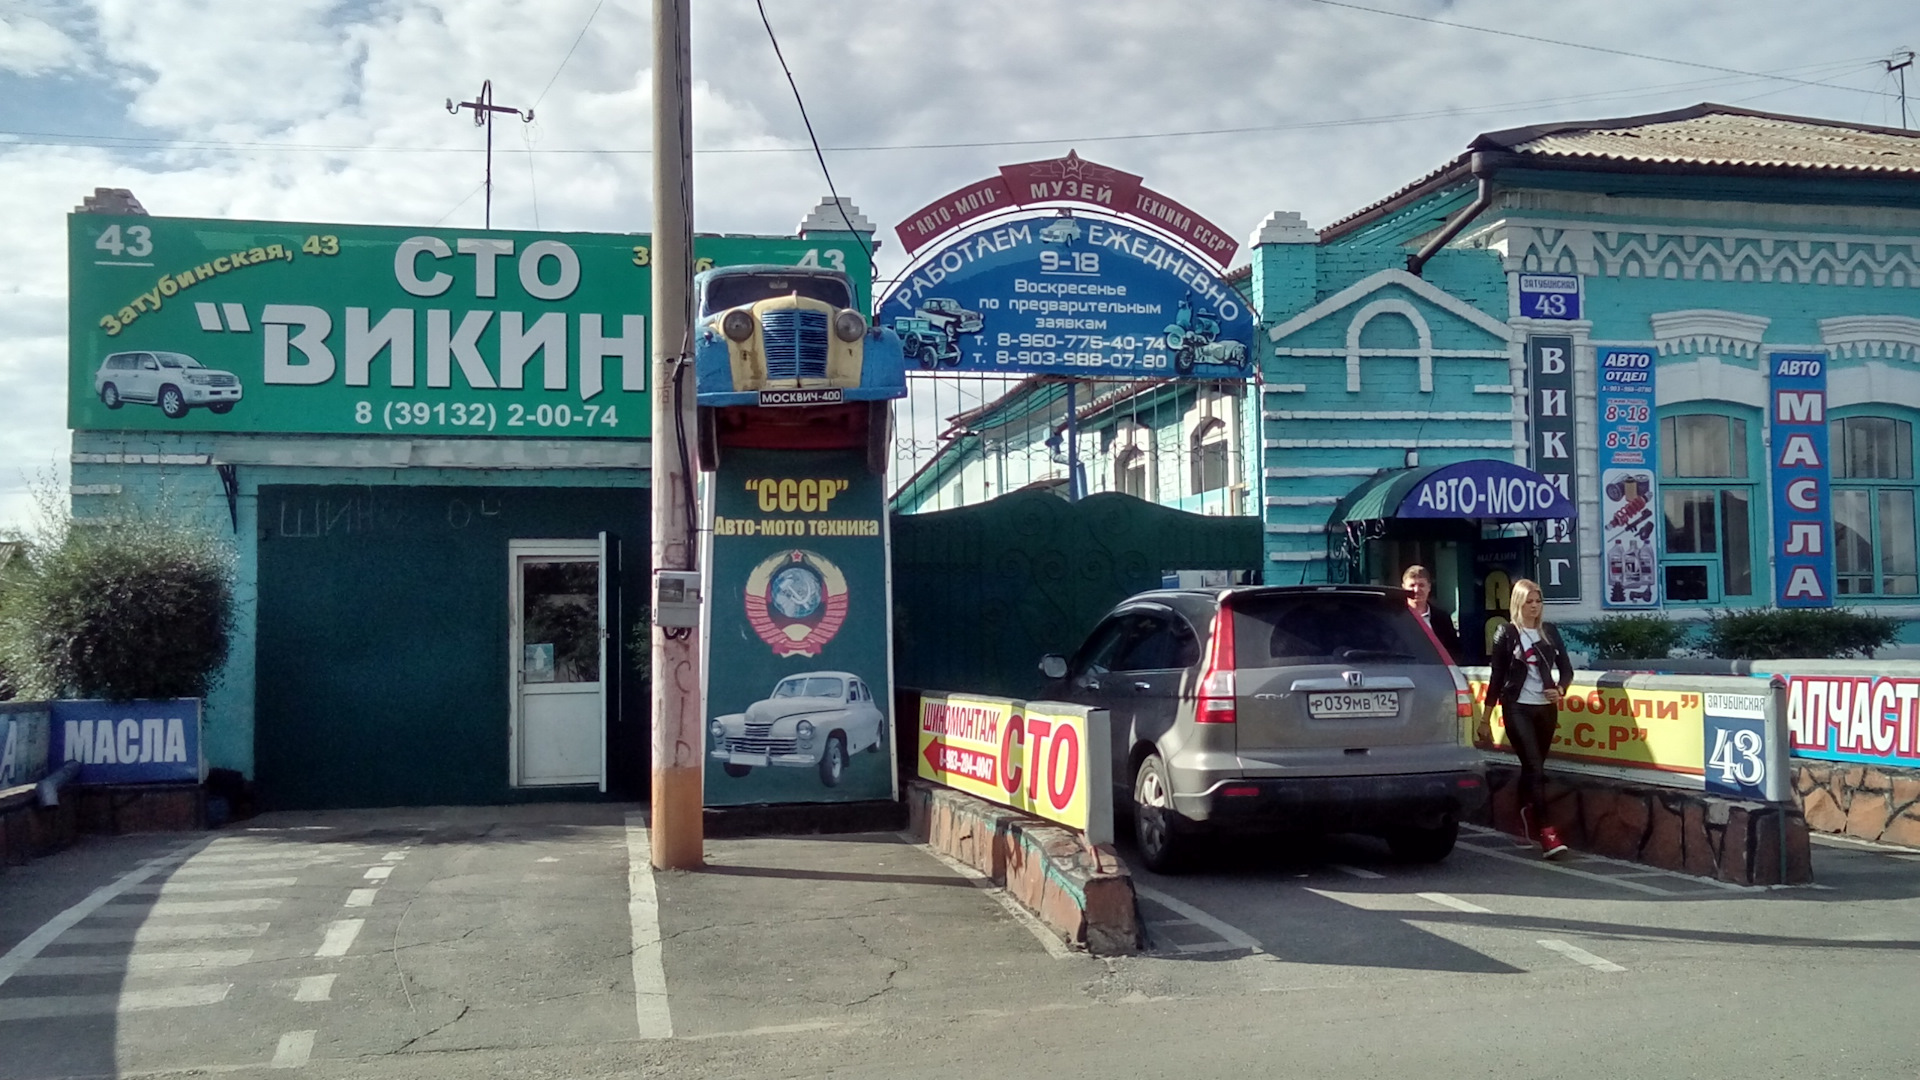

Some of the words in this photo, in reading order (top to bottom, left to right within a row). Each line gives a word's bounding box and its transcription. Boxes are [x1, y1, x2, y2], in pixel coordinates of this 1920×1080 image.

[1030, 180, 1113, 204] МУЗЕЙ
[1136, 193, 1192, 232] ТЕХНИКА
[1193, 224, 1234, 252] СССР"
[96, 224, 153, 257] 43
[395, 236, 582, 300] СТО
[896, 224, 1032, 311] РАБОТАЕМ
[1088, 224, 1239, 321] ЕЖЕДНЕВНО
[1040, 251, 1100, 273] 9-18
[99, 243, 293, 336] Затубинская,
[302, 234, 340, 255] 43
[1014, 279, 1127, 298] Воскресенье
[979, 298, 1000, 309] по
[1008, 299, 1162, 316] предварительным
[1535, 294, 1567, 316] 43
[1035, 317, 1107, 330] заявкам
[194, 301, 645, 401] "ВИКИН
[974, 335, 988, 346] т.
[997, 332, 1167, 351] 8-960-775-40-74
[972, 353, 987, 364] т.
[995, 350, 1167, 368] 8-903-988-07-80
[1605, 353, 1650, 368] АВТО
[1778, 360, 1820, 376] АВТО
[1605, 371, 1648, 383] ОТДЕЛ
[761, 390, 841, 404] МОСКВИЧ-400
[356, 402, 372, 425] 8
[383, 401, 497, 431] (39132)
[507, 403, 618, 429] 2-00-74
[745, 478, 849, 513] "СССР"
[1418, 476, 1555, 514] АВТО-МОТО
[1777, 391, 1826, 599] МАСЛА
[714, 515, 806, 537] Авто-мото
[807, 519, 880, 537] техника
[1373, 693, 1395, 706] 124
[1707, 694, 1765, 712] ЗАТУБИНСКАЯ
[923, 702, 1000, 745] ШИНОМОНТАЖ
[1786, 679, 1920, 754] АПЧАСТ
[64, 718, 188, 764] МАСЛА
[939, 747, 993, 781] 8-983-204-0047
[1001, 714, 1079, 810] СТО
[1707, 727, 1765, 787] 43
